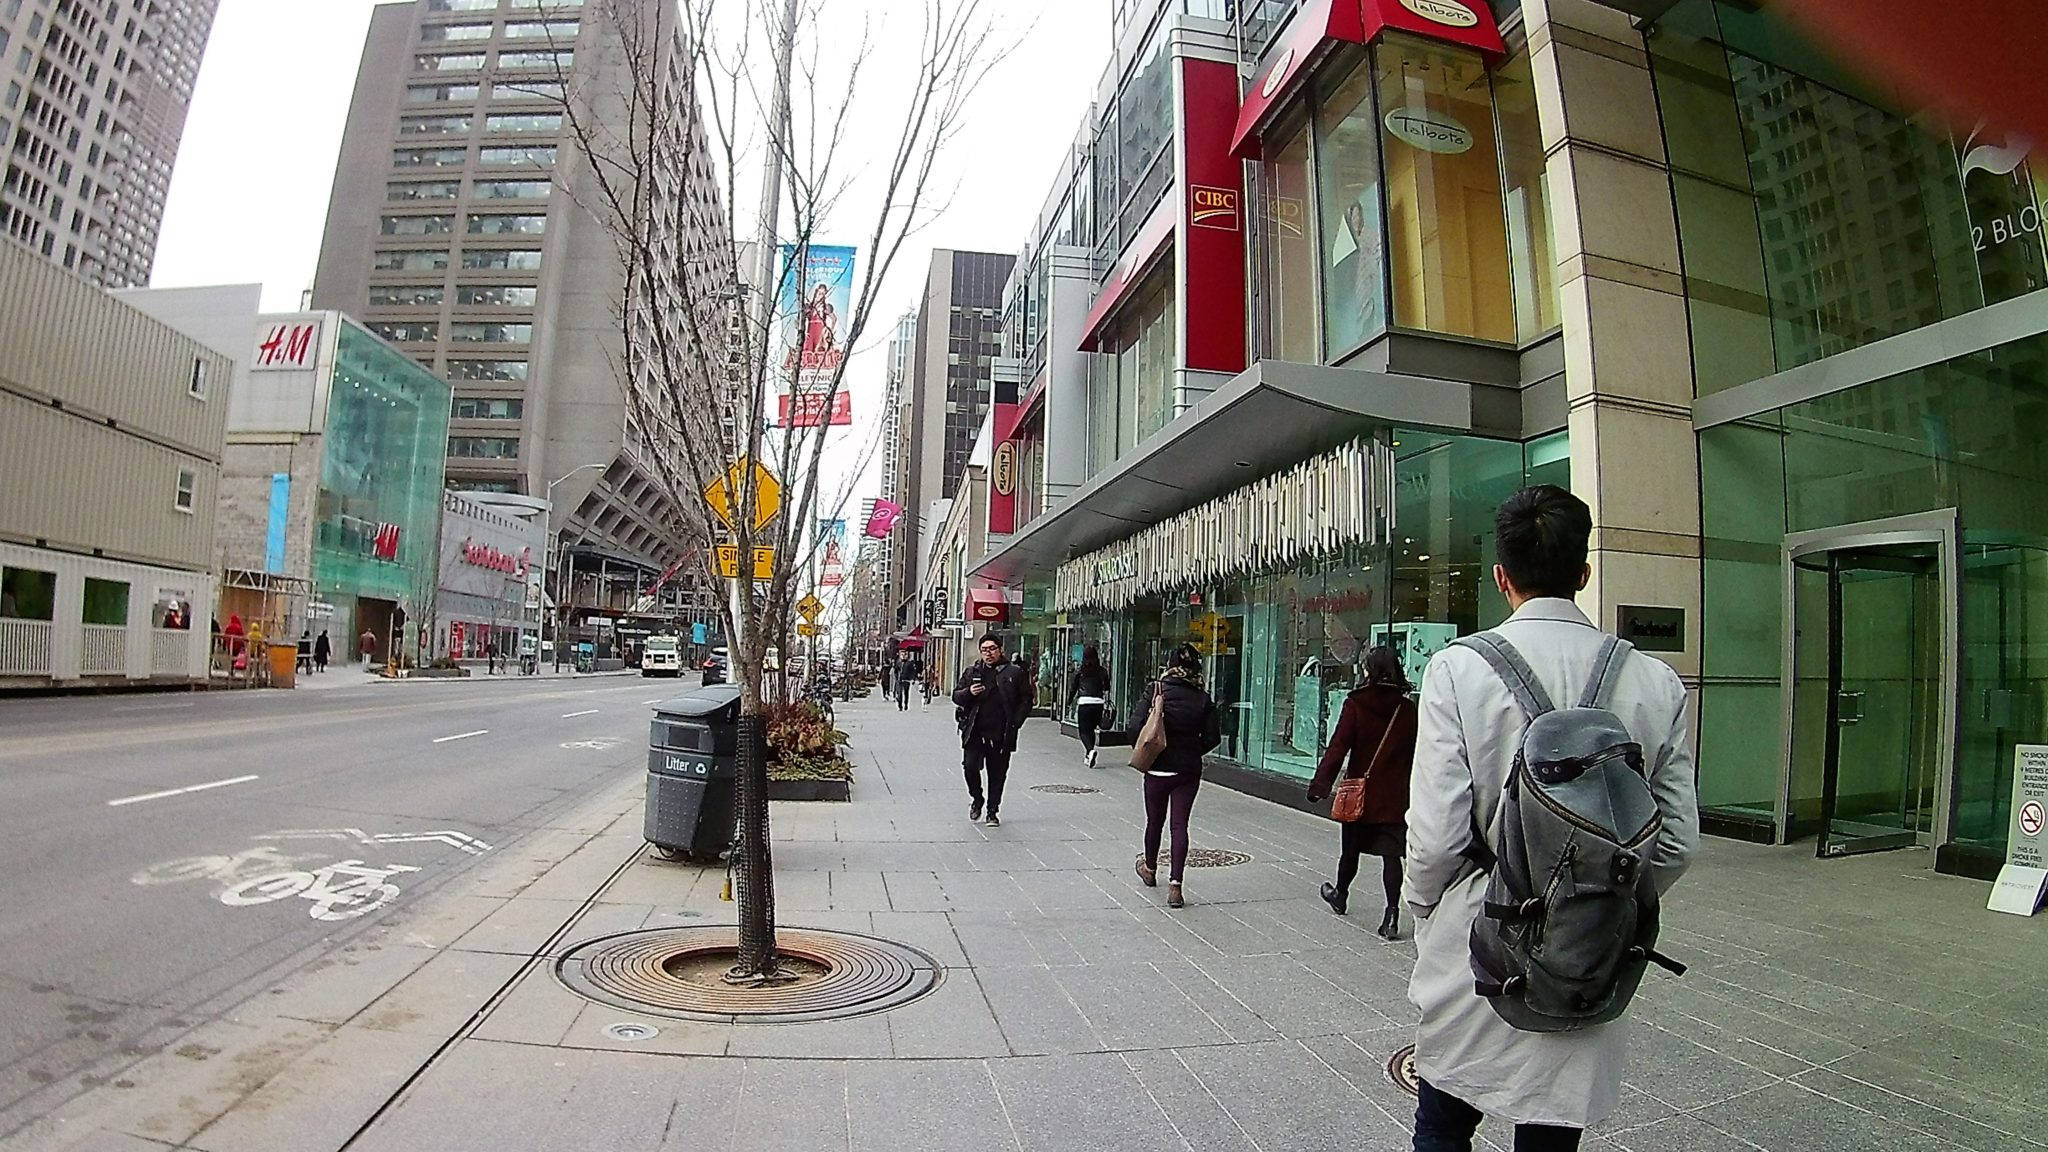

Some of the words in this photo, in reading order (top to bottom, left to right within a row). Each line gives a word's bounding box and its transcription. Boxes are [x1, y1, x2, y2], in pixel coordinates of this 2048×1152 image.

[1413, 0, 1471, 22] Talbots
[1393, 116, 1466, 145] Talbots
[1194, 190, 1235, 208] CIBC
[1972, 226, 1986, 252] 2
[257, 325, 314, 366] H&M
[999, 445, 1012, 493] Talbots
[665, 755, 690, 772] Litter
